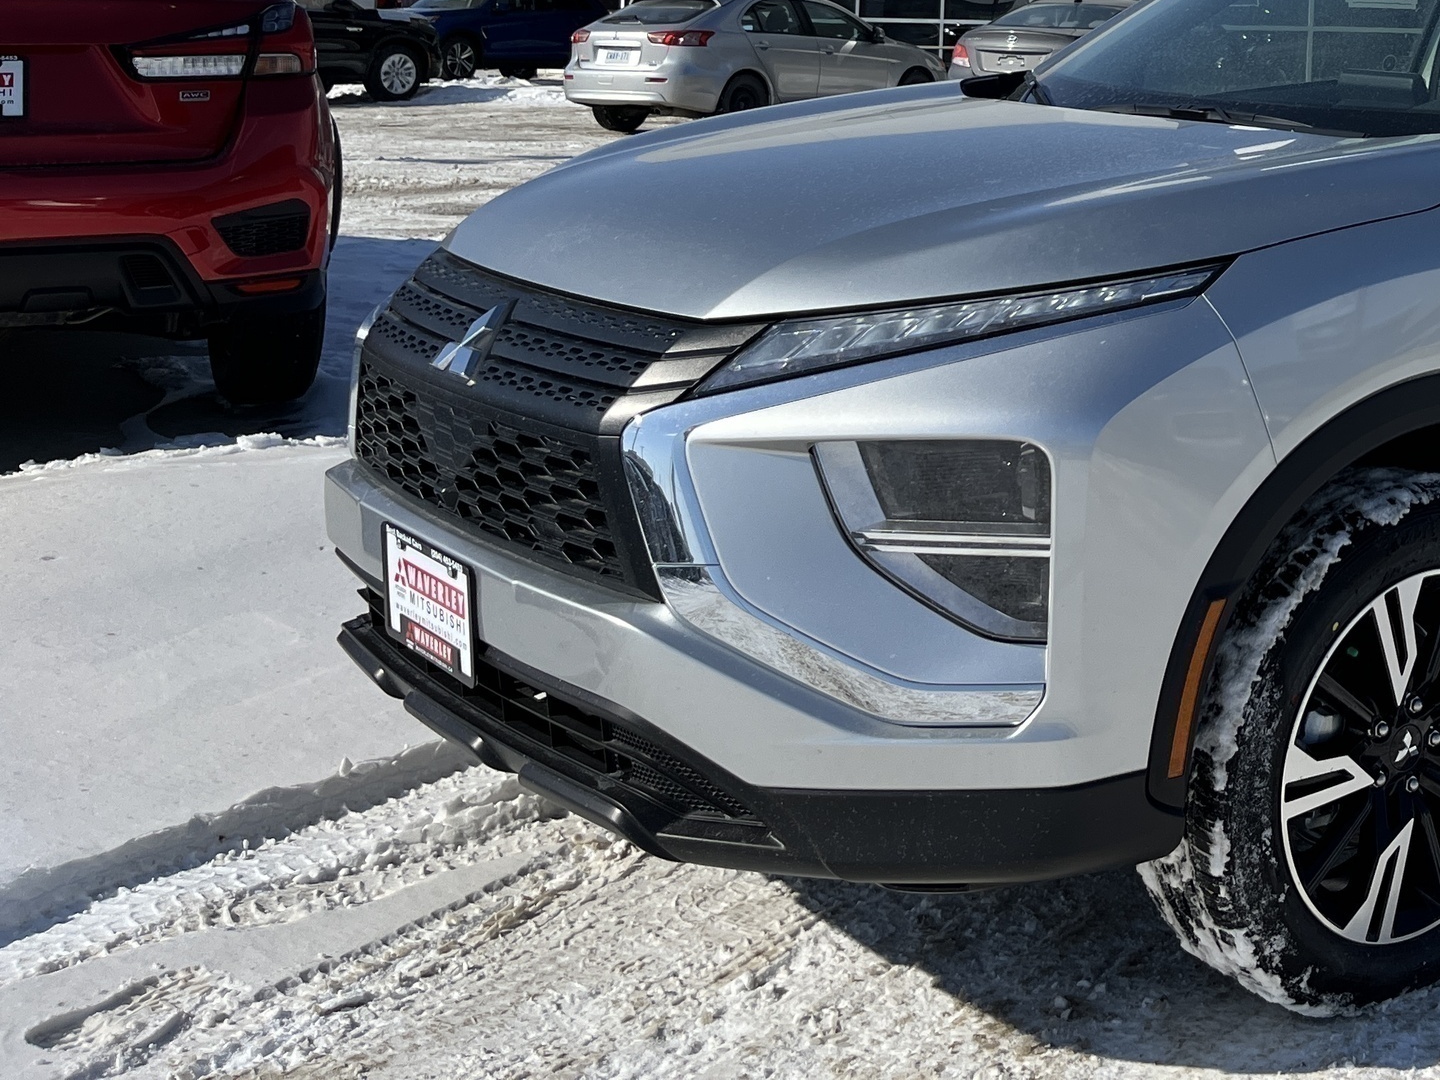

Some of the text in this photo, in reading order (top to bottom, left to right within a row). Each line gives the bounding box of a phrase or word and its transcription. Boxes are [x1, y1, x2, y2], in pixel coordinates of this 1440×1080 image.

[406, 563, 465, 616] WAVERLEY
[409, 590, 466, 636] MITSUBISHI
[413, 625, 452, 662] WAVERLEY
